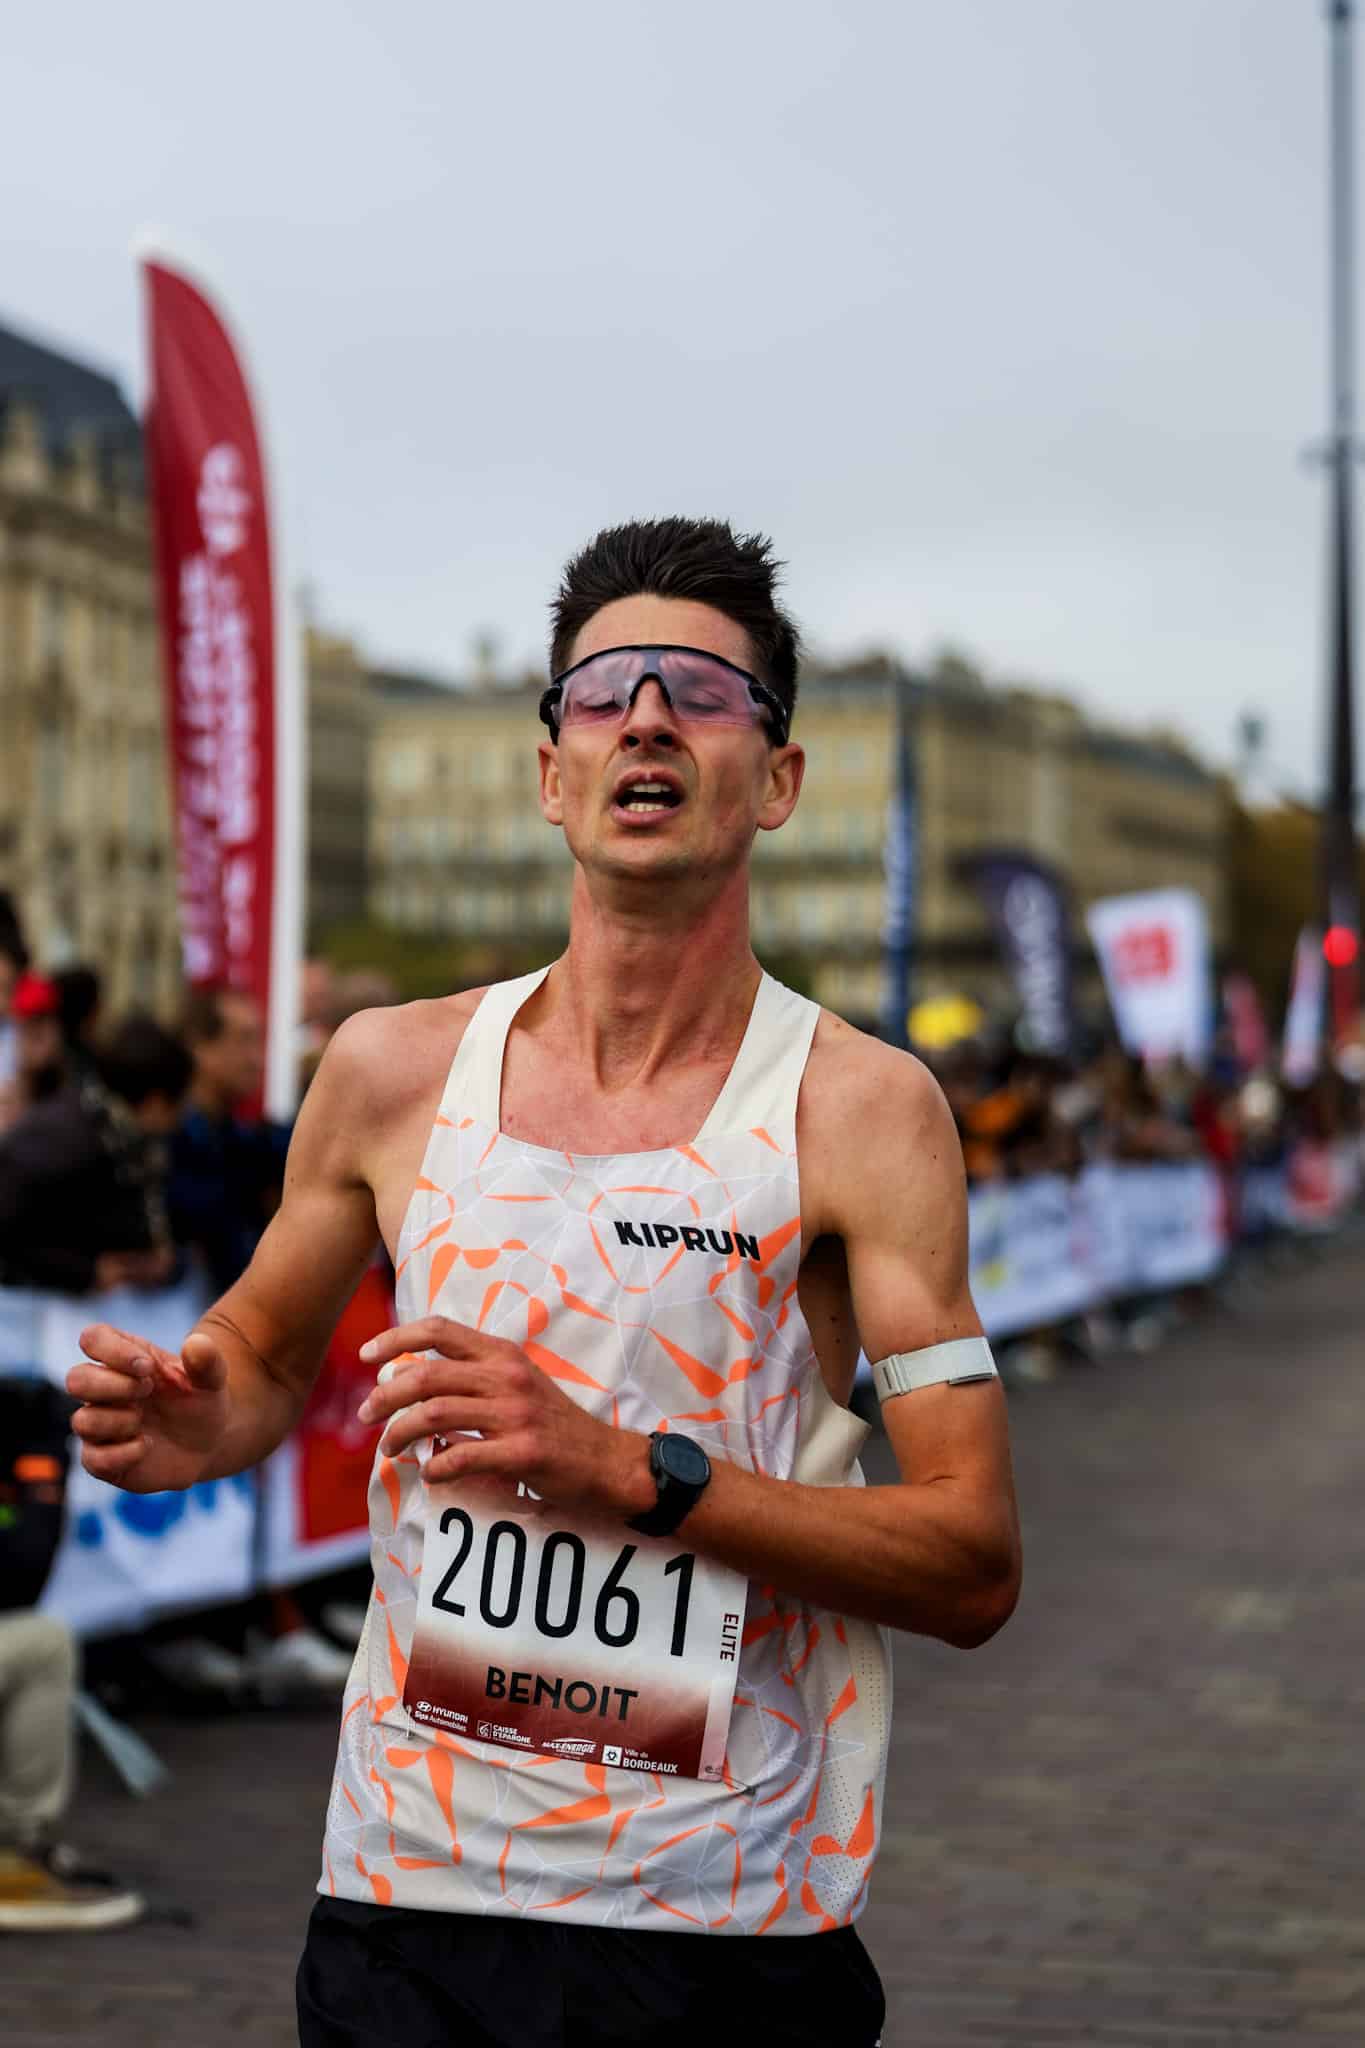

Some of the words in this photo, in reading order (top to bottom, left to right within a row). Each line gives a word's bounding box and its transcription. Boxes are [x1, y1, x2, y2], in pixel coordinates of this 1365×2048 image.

[613, 1221, 761, 1261] KIPRUN
[431, 1507, 696, 1657] 20061
[719, 1613, 740, 1662] ELITE
[485, 1666, 639, 1721] BENOIT
[432, 1705, 469, 1723] HYUNDAI
[492, 1724, 518, 1735] CAISSE
[622, 1757, 679, 1774] BORDEAUX
